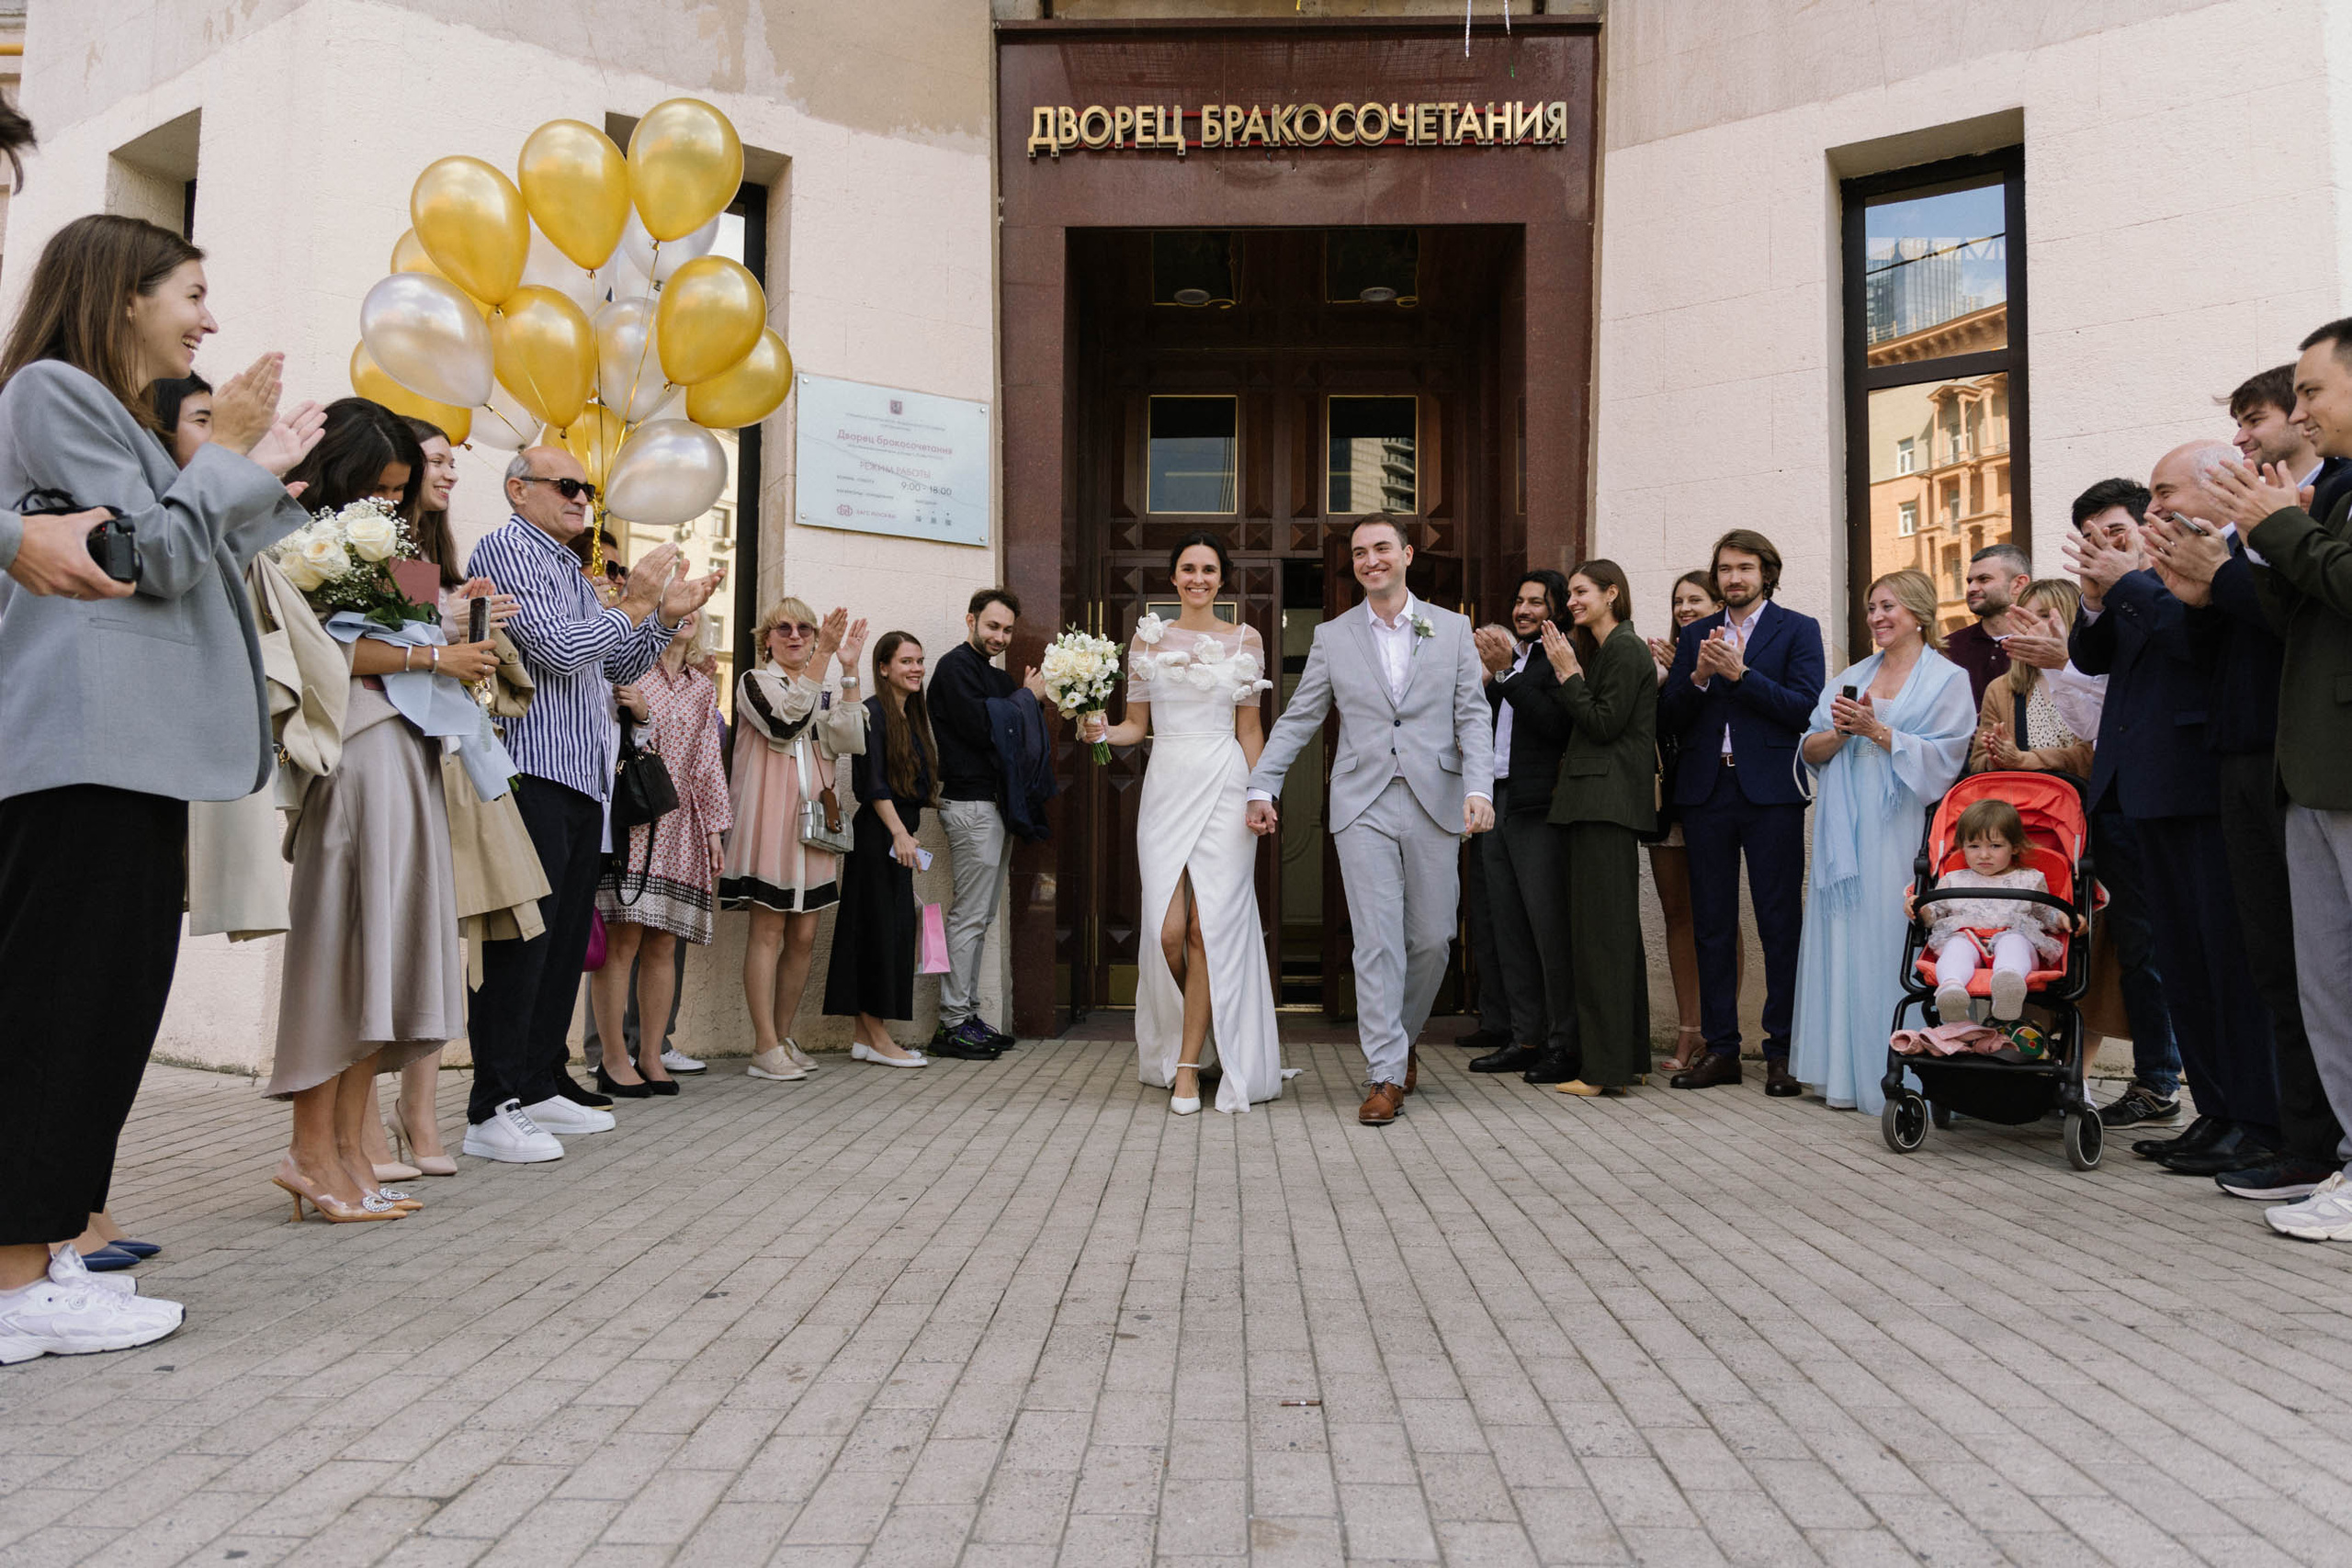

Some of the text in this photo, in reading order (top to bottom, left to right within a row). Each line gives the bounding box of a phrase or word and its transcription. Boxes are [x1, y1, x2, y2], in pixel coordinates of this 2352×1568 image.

[1028, 100, 1567, 157] ДВОРЕЦ БРАКОСОЧЕТАНИЯ
[837, 429, 875, 444] Дворец
[896, 466, 931, 479] РАБОТЫ
[901, 481, 921, 491] 9:00
[929, 485, 952, 496] 18:00
[2127, 1097, 2155, 1118] N
